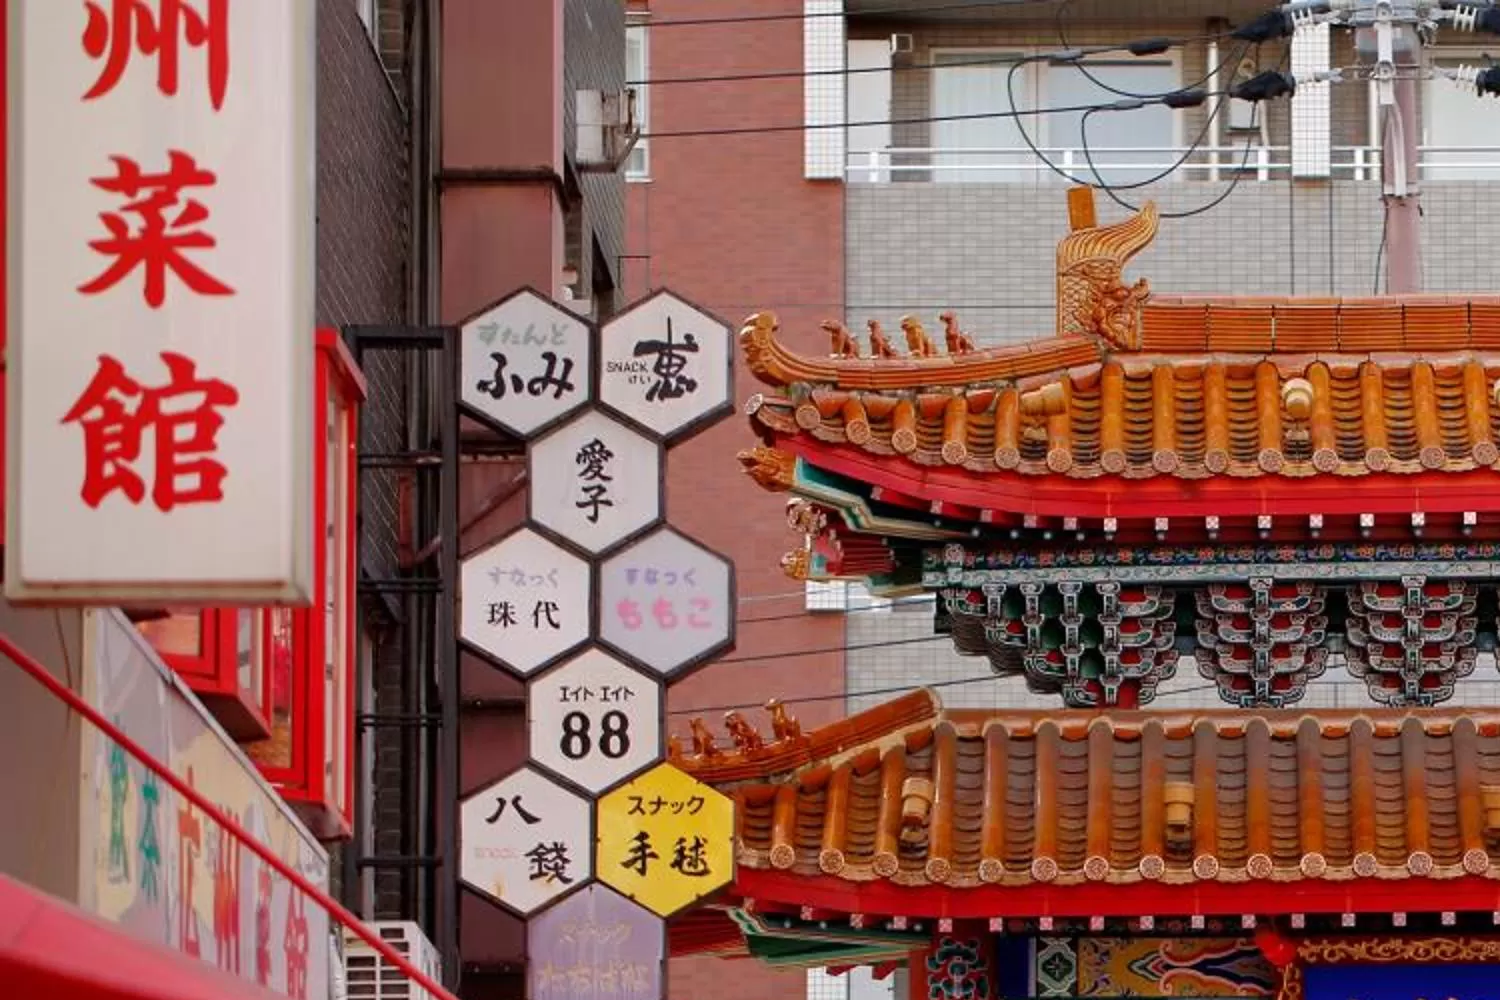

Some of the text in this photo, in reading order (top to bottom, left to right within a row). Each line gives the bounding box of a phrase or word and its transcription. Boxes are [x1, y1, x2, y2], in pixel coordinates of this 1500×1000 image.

[477, 322, 570, 346] すたんど
[477, 352, 574, 399] ふみ
[607, 361, 649, 373] SNACK
[576, 439, 614, 523] 愛子
[489, 567, 559, 588] すなっく
[625, 568, 697, 586] すなっく
[487, 601, 561, 630] 珠代
[616, 596, 712, 631] ももこ
[560, 711, 630, 759] 88
[627, 796, 705, 815] スナック
